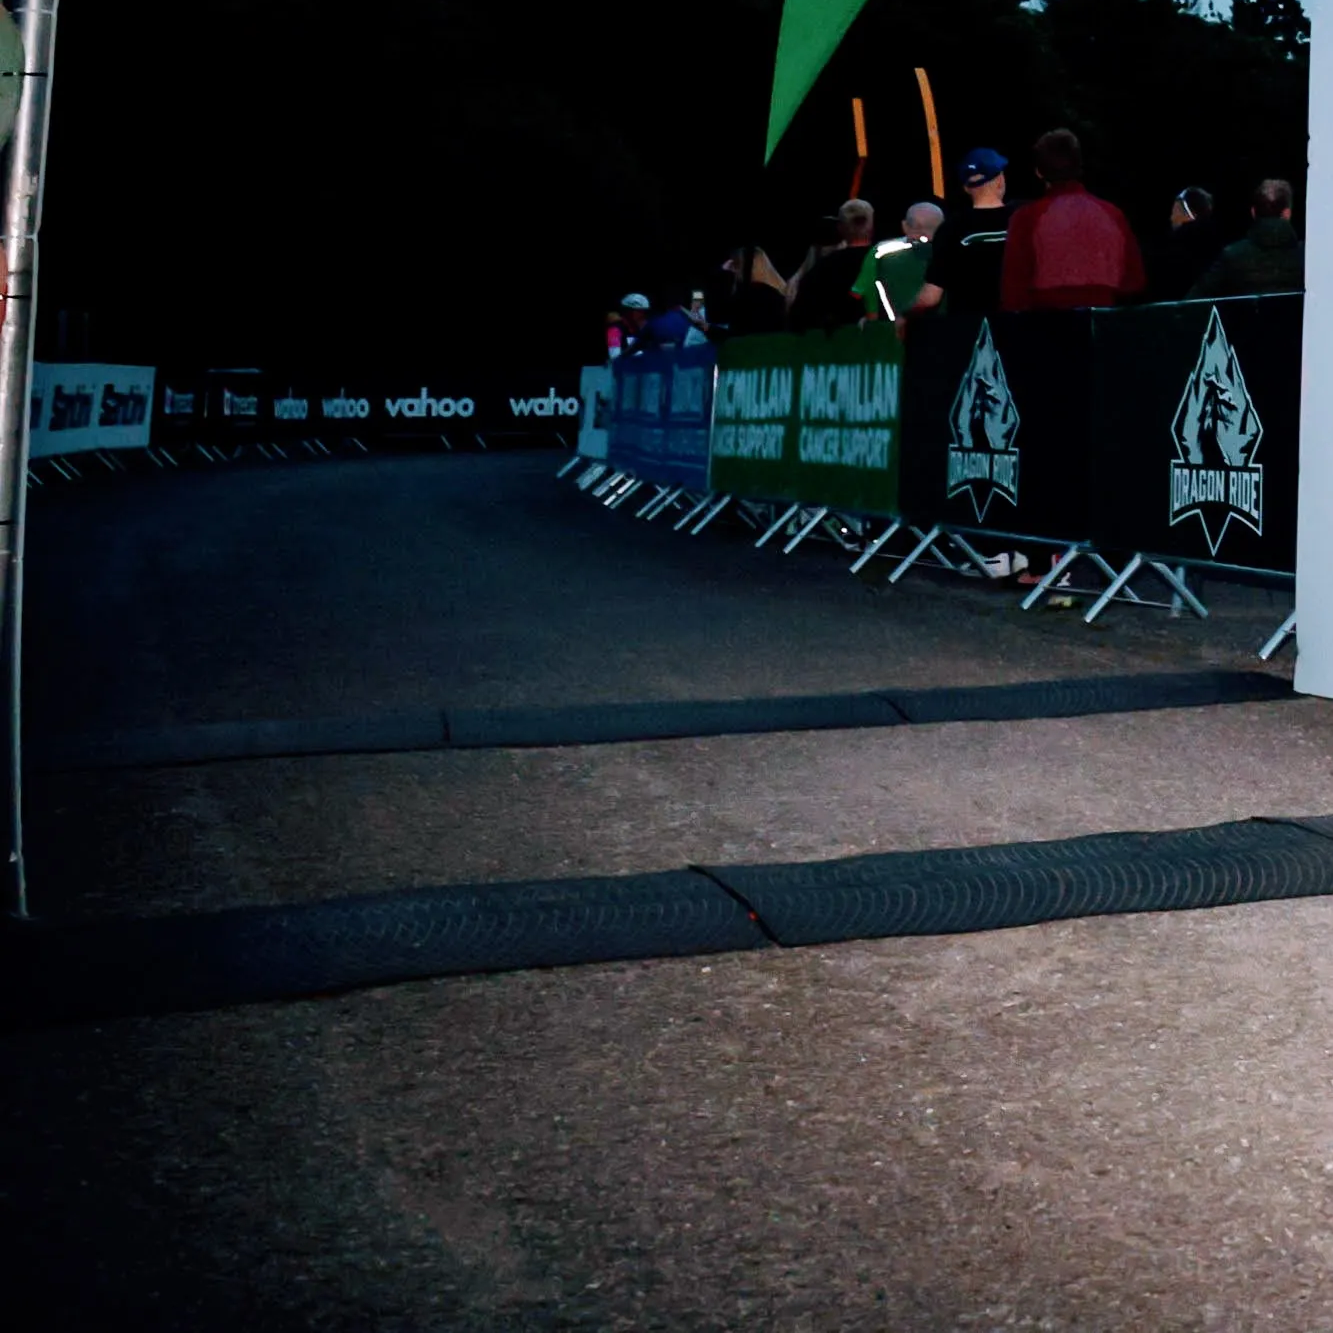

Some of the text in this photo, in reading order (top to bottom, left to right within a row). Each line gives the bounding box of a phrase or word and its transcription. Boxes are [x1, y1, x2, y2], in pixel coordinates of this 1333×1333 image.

[801, 363, 899, 423] MACMILLAN
[1173, 467, 1260, 521] DRAGON RIDE
